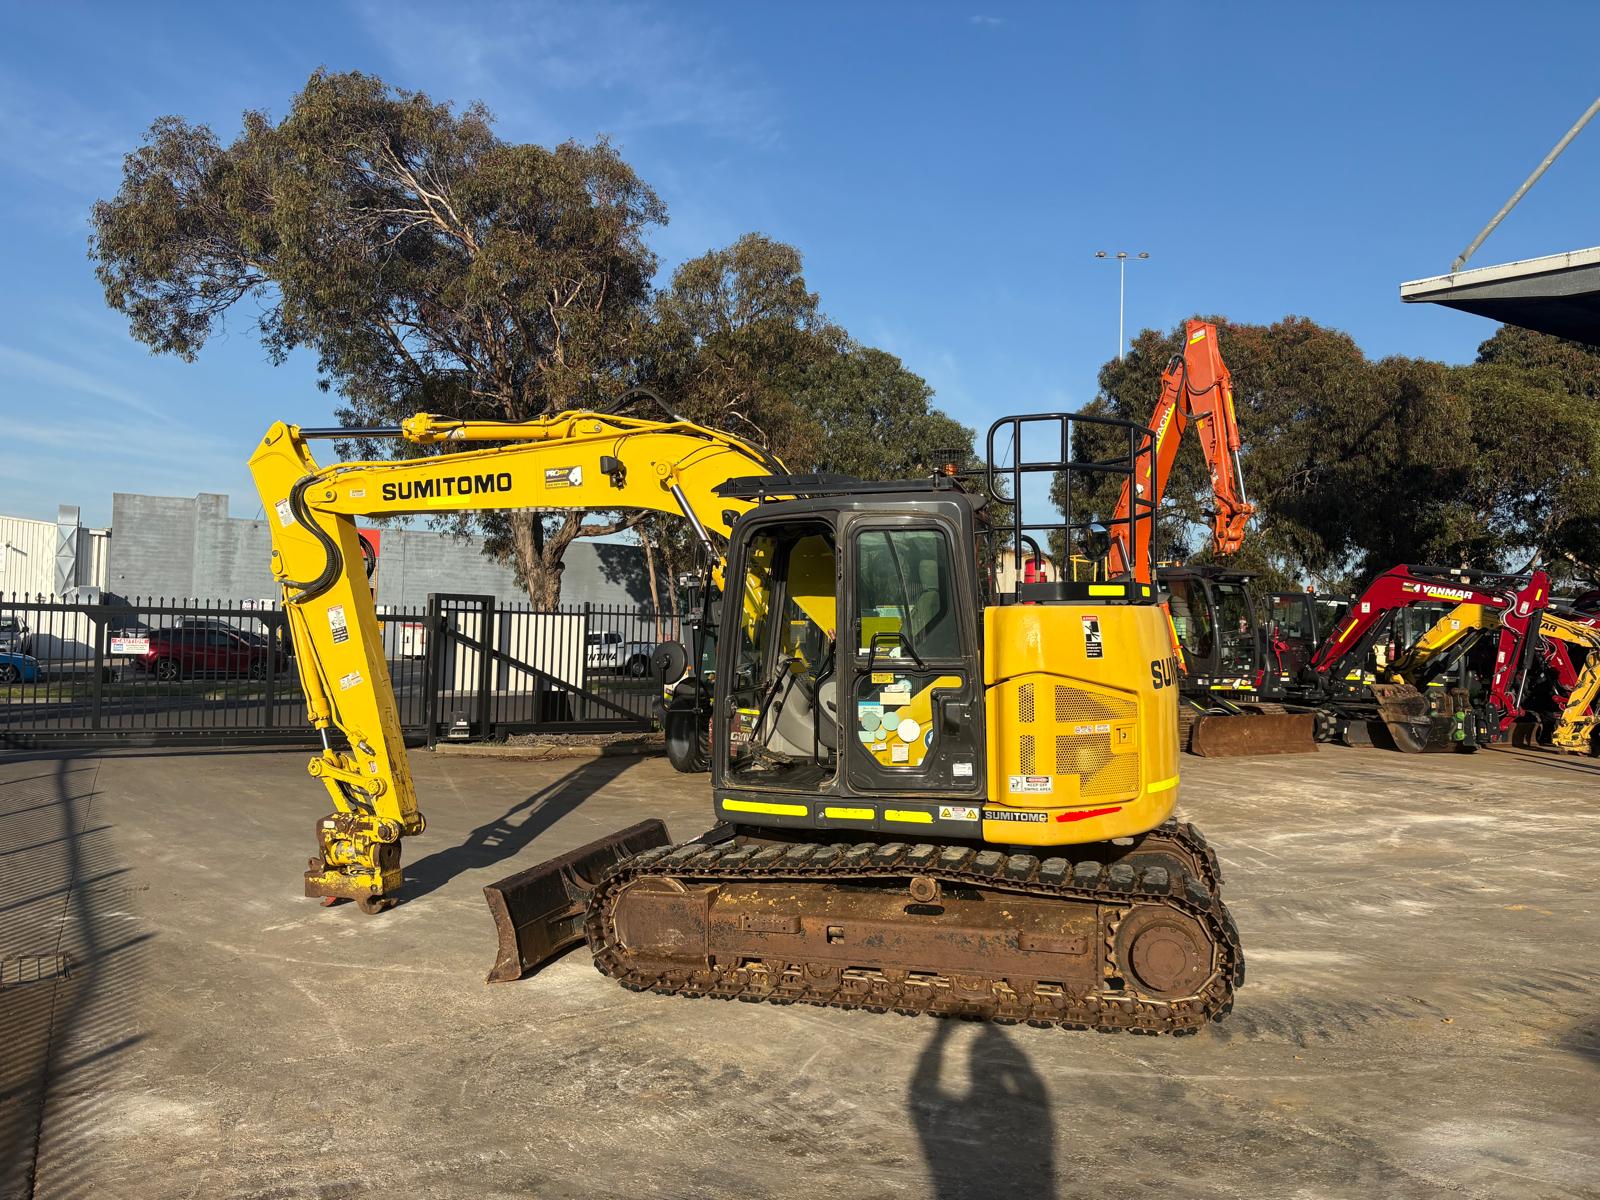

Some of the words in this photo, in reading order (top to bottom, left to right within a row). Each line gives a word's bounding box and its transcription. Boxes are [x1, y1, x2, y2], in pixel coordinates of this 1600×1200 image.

[382, 472, 512, 501] SUMITOMO
[1422, 584, 1473, 599] YANMAR
[985, 811, 1047, 822] SUMITOMO
